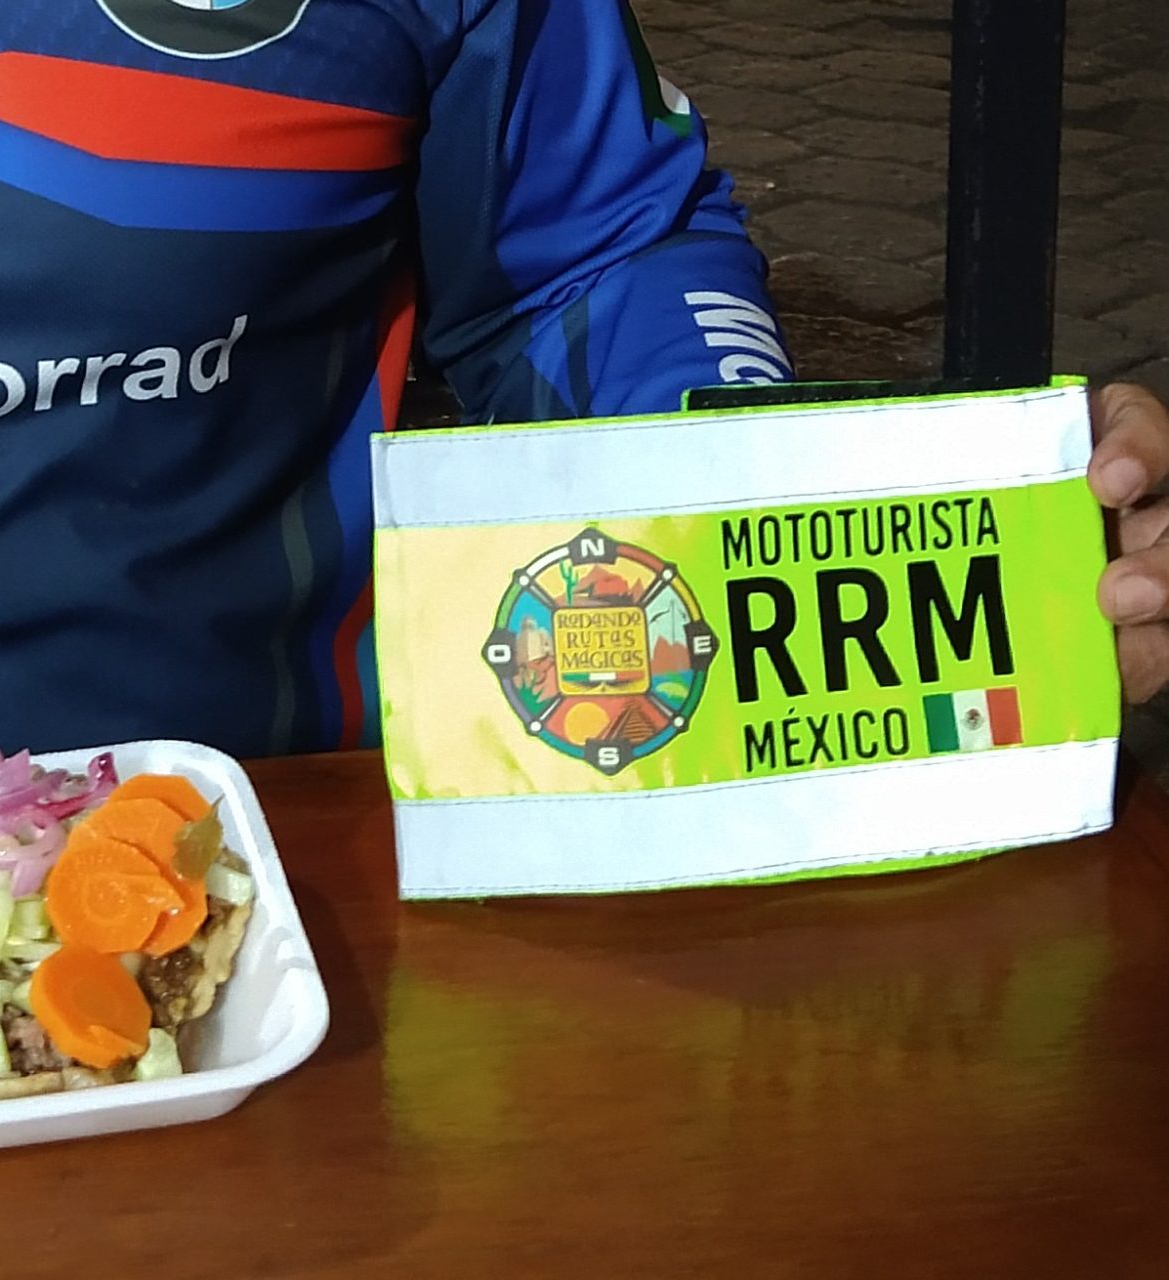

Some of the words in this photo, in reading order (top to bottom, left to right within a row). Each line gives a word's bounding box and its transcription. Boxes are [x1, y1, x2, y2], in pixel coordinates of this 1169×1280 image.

[721, 496, 1000, 571] MOTOTURISTA
[580, 538, 606, 558] N
[725, 553, 1016, 704] RRM
[487, 643, 512, 663] O
[692, 634, 713, 655] E
[743, 706, 911, 773] MÉXICO
[597, 746, 620, 766] S
